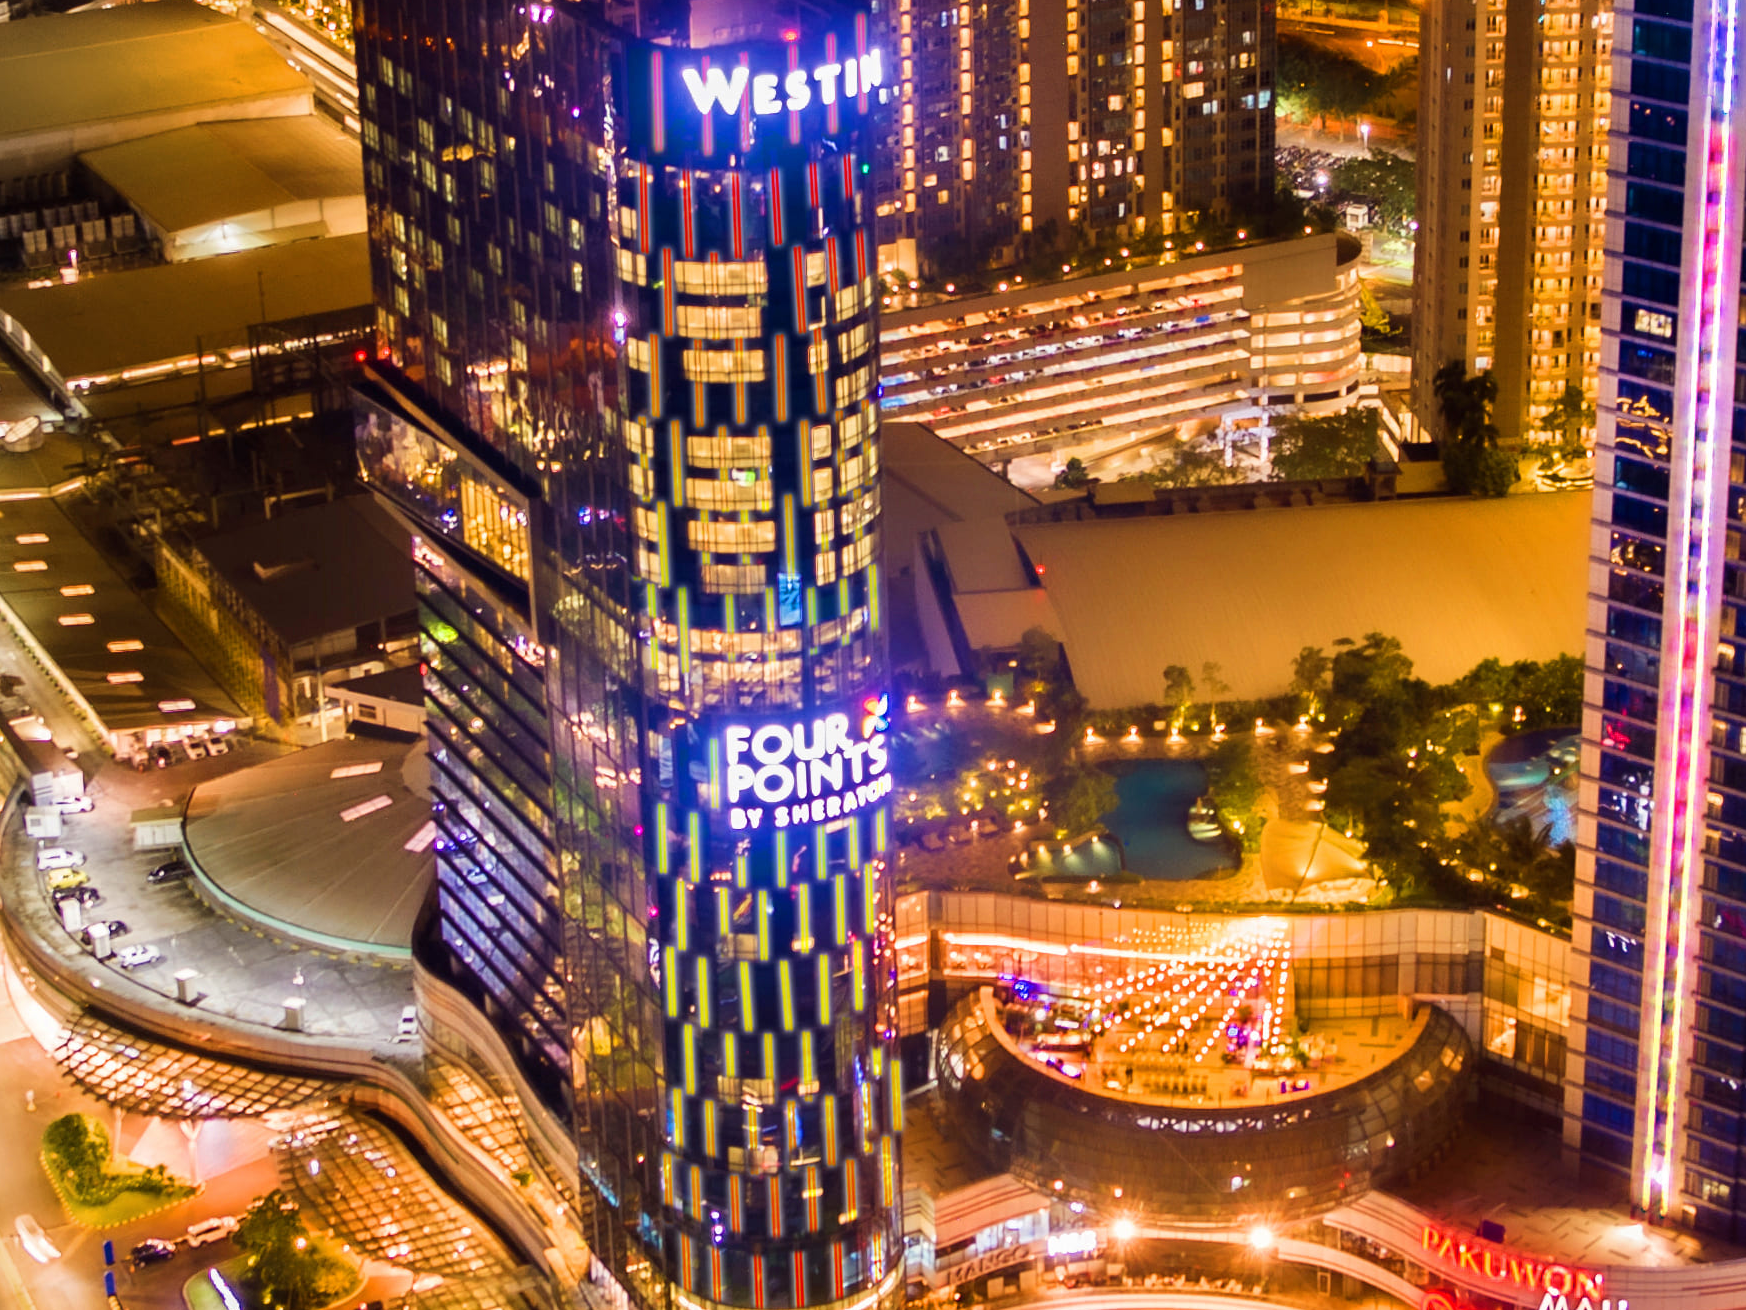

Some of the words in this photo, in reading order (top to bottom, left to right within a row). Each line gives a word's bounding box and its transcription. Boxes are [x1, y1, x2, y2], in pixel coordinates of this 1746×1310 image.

[726, 713, 853, 765] FOUR
[727, 734, 889, 804] POINTS
[730, 807, 763, 830] BY
[774, 772, 894, 828] SHERATON
[1421, 1224, 1605, 1300] PAKUWON
